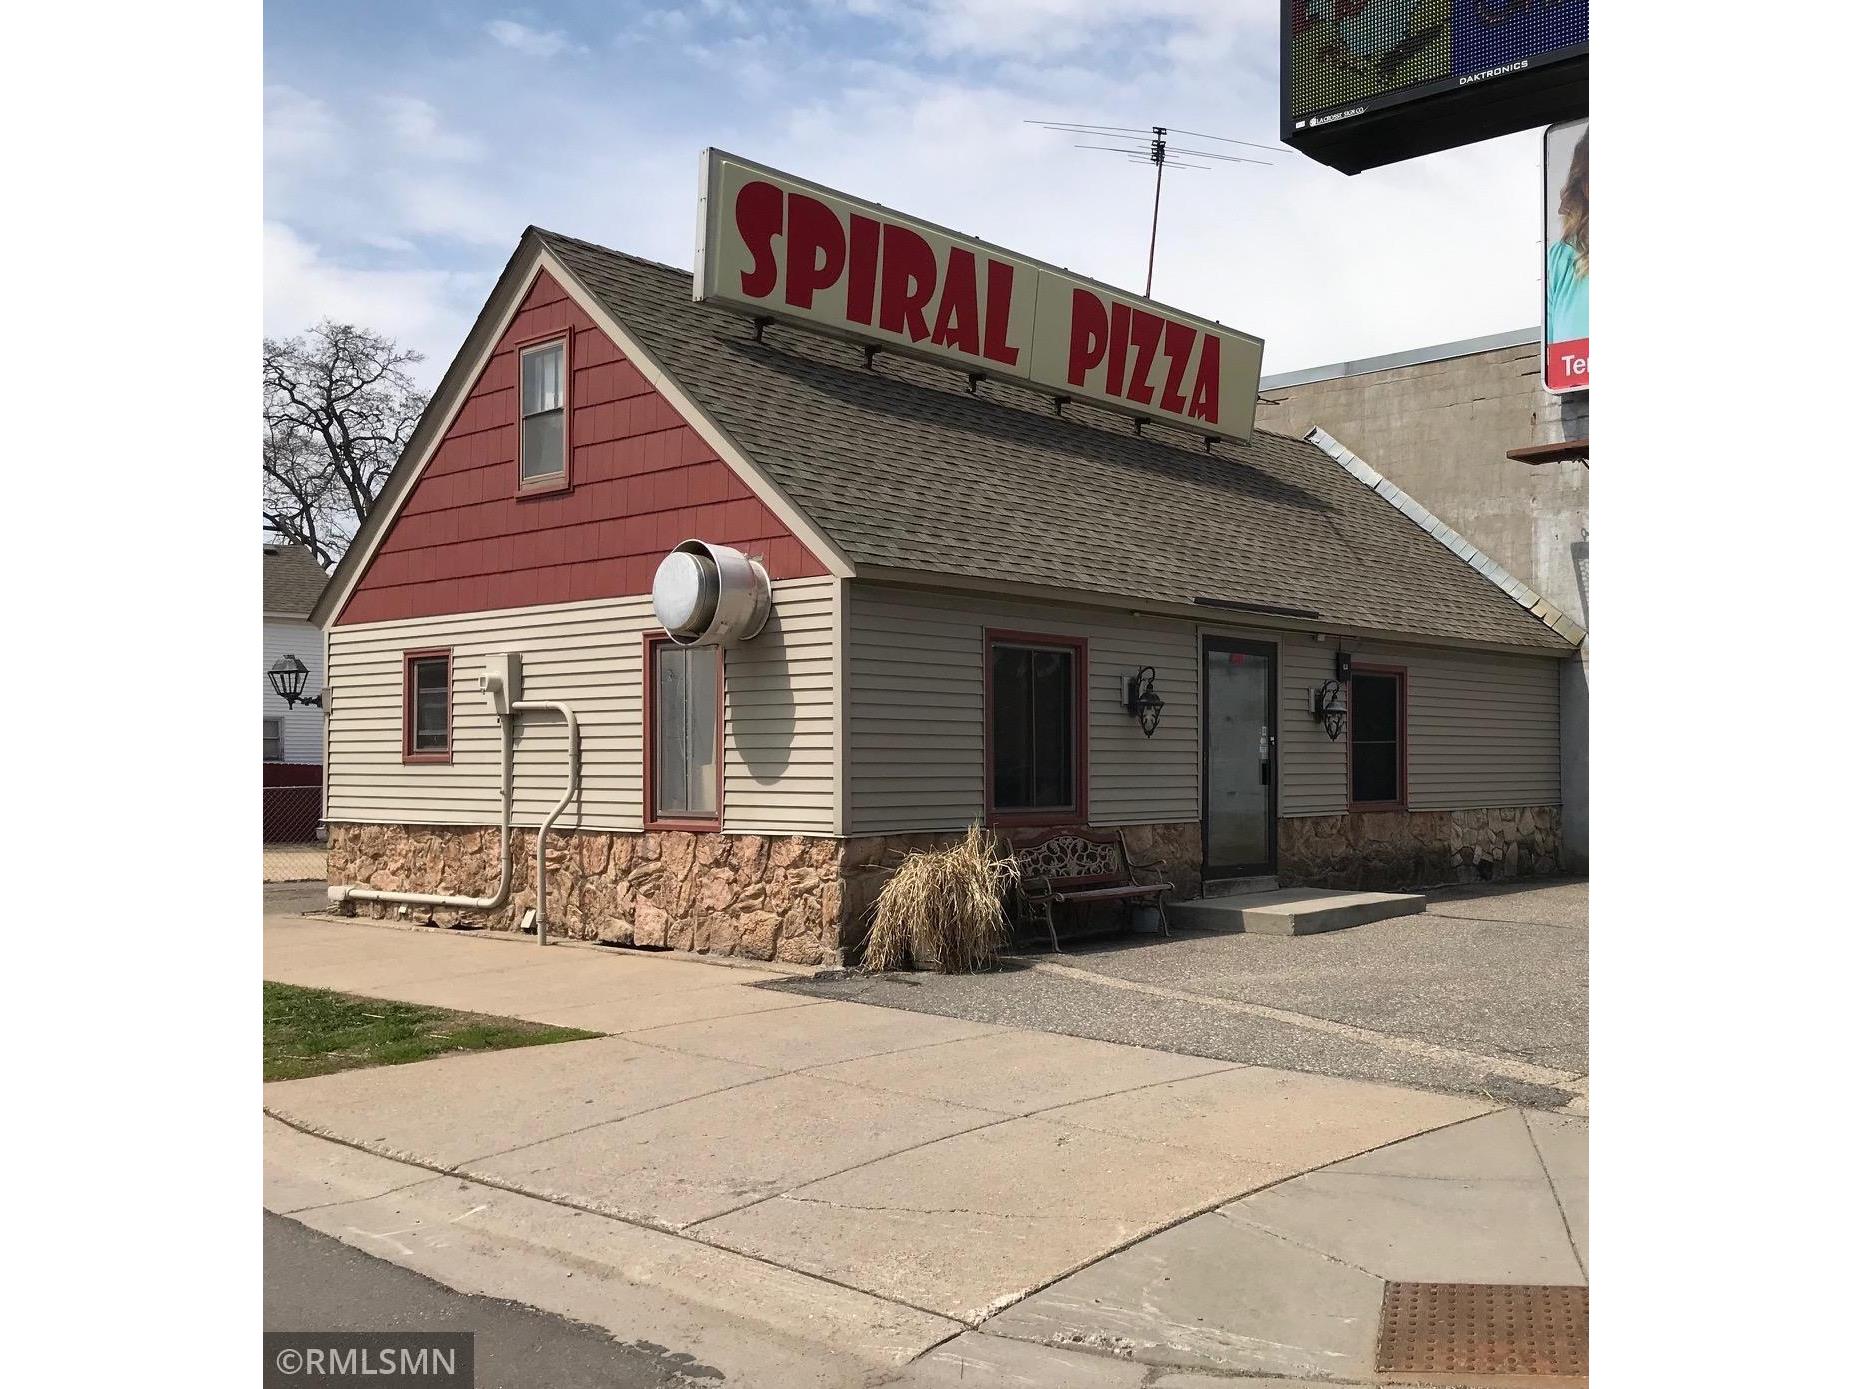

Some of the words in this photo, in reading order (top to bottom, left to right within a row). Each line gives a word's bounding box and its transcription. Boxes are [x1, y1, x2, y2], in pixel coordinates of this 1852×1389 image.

[1460, 60, 1528, 85] DAKTRONICS
[735, 181, 1019, 366] SPIRAL
[1067, 288, 1220, 425] PIZZA
[1561, 354, 1589, 376] Te
